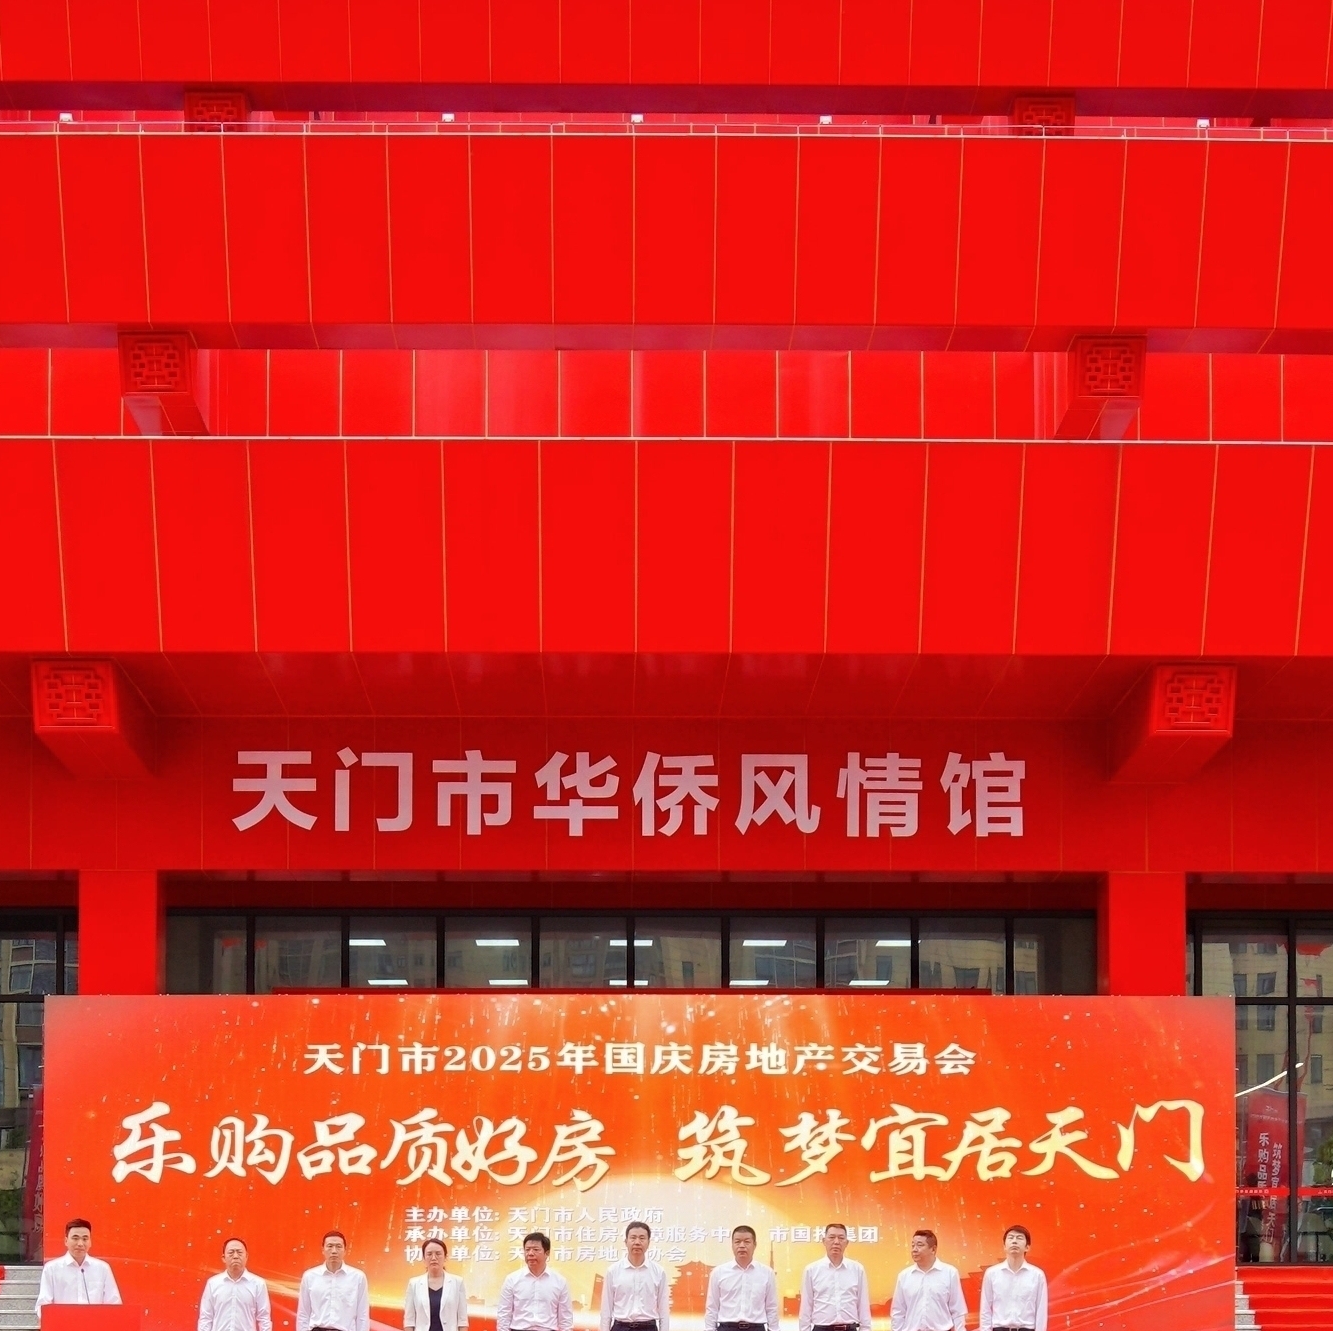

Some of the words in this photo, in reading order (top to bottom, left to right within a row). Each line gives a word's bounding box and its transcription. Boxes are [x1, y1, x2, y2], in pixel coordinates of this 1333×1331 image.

[231, 747, 1029, 840] 天门市华侨风情馆
[303, 1041, 978, 1076] 天门市2025年国庆房地产交易会
[110, 1101, 617, 1192] 乐购品质好房
[674, 1099, 1206, 1187] 筑梦宜居天门
